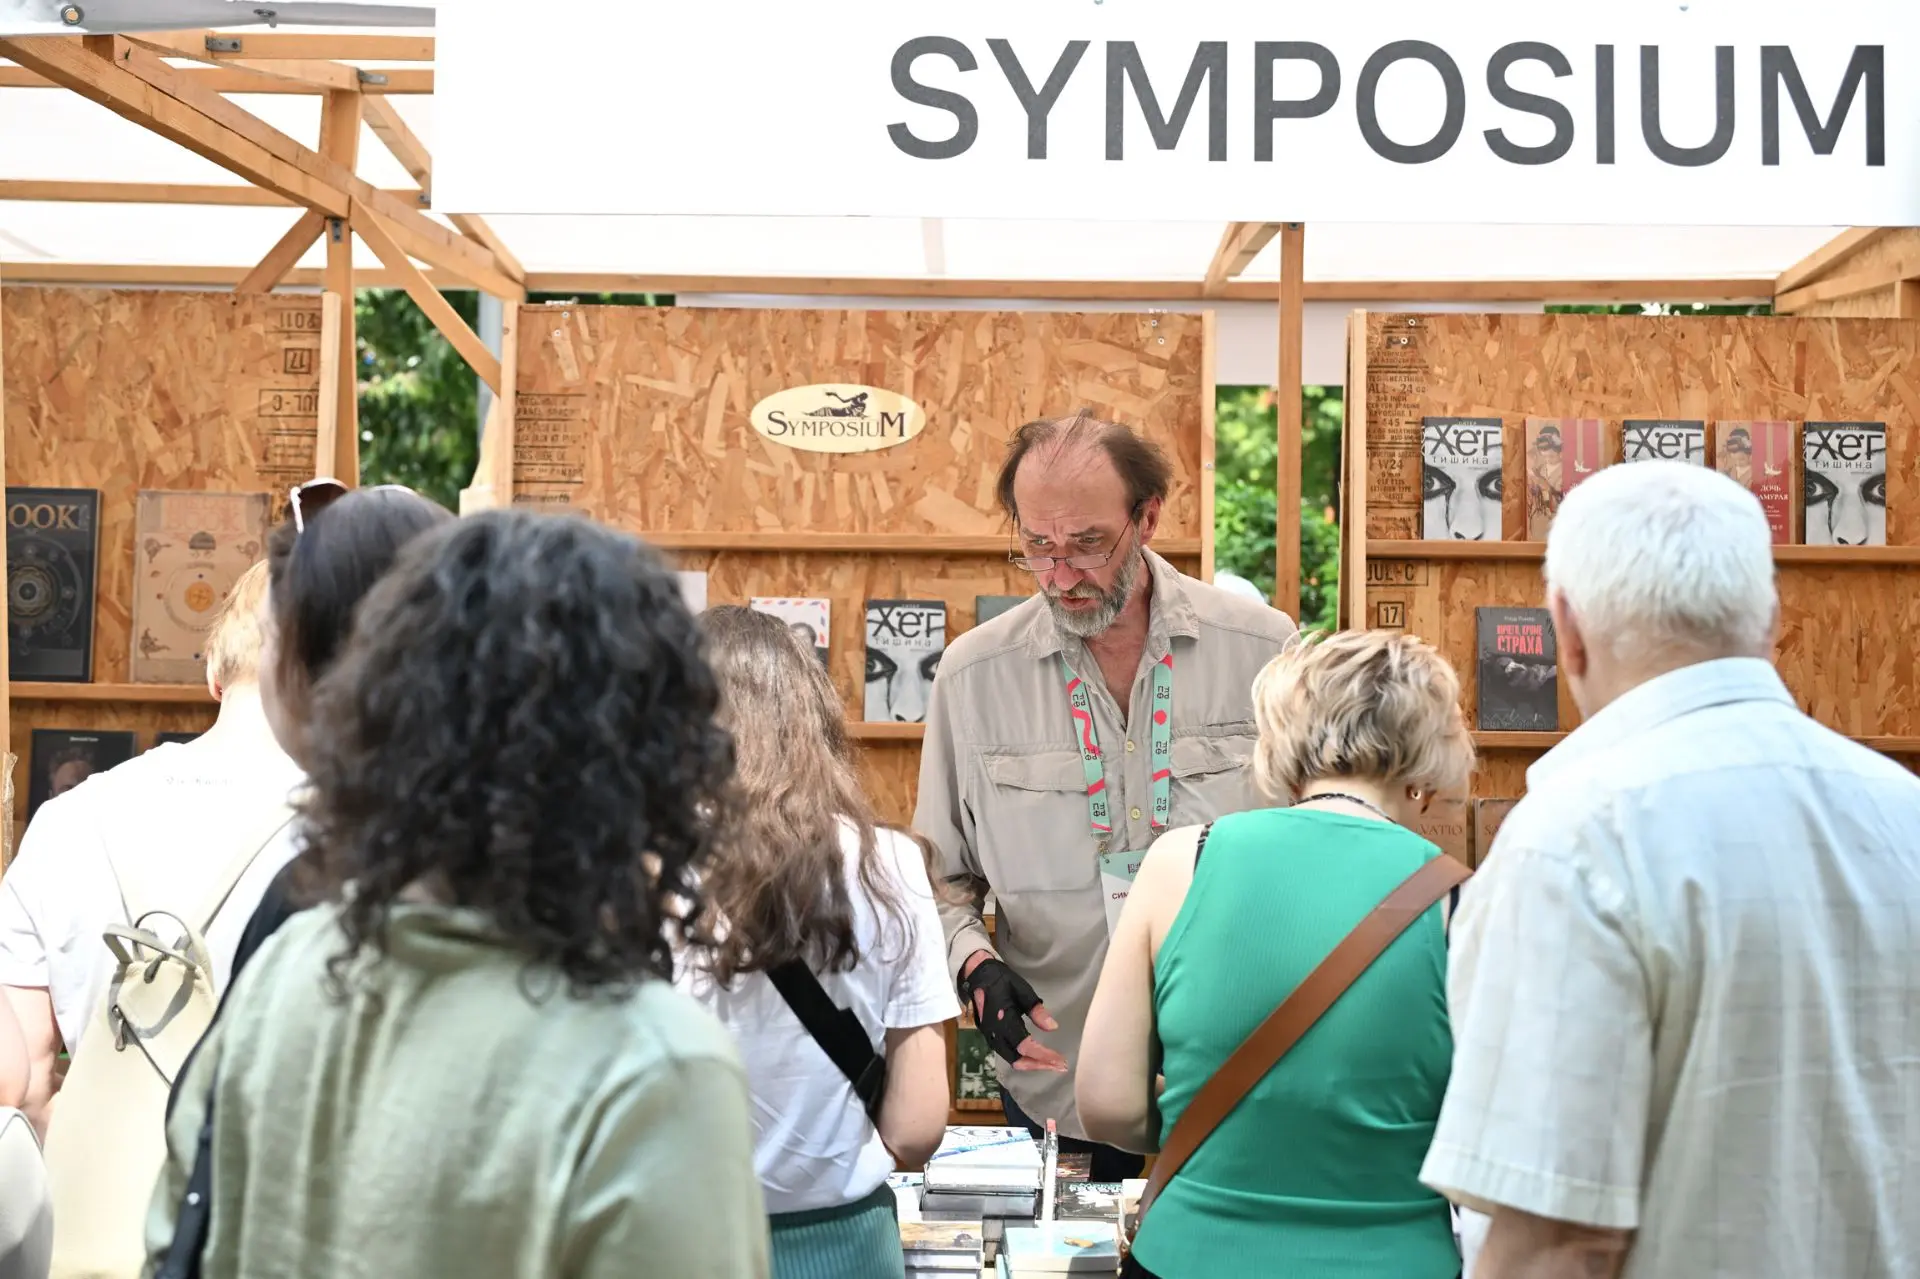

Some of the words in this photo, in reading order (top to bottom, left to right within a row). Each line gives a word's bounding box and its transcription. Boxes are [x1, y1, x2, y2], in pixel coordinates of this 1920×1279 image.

[886, 35, 1886, 167] SYMPOSIUM
[1814, 461, 1872, 469] тишина
[1383, 606, 1398, 624] 17
[1497, 635, 1543, 656] СТРАХА
